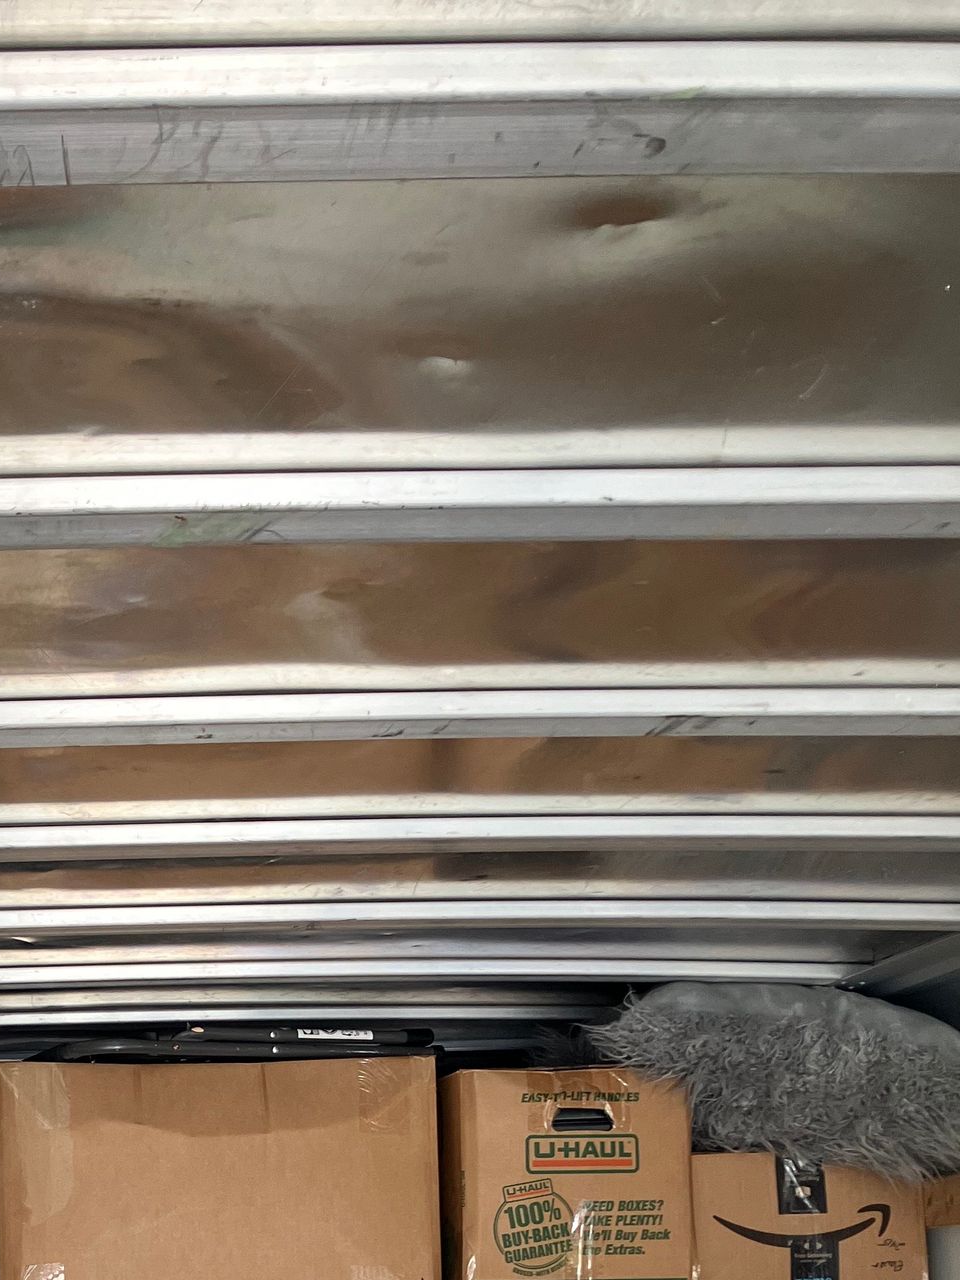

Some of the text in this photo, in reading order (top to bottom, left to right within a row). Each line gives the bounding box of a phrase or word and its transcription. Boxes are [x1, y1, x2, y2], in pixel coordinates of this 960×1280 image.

[534, 1141, 632, 1158] U-HAUL
[618, 1200, 664, 1211] BOXES?
[504, 1198, 562, 1229] 100%
[615, 1214, 663, 1226] PLENTY!
[502, 1222, 571, 1249] BUY-BACK
[615, 1230, 638, 1242] Buy
[641, 1229, 671, 1240] Back
[605, 1244, 646, 1255] Extras.
